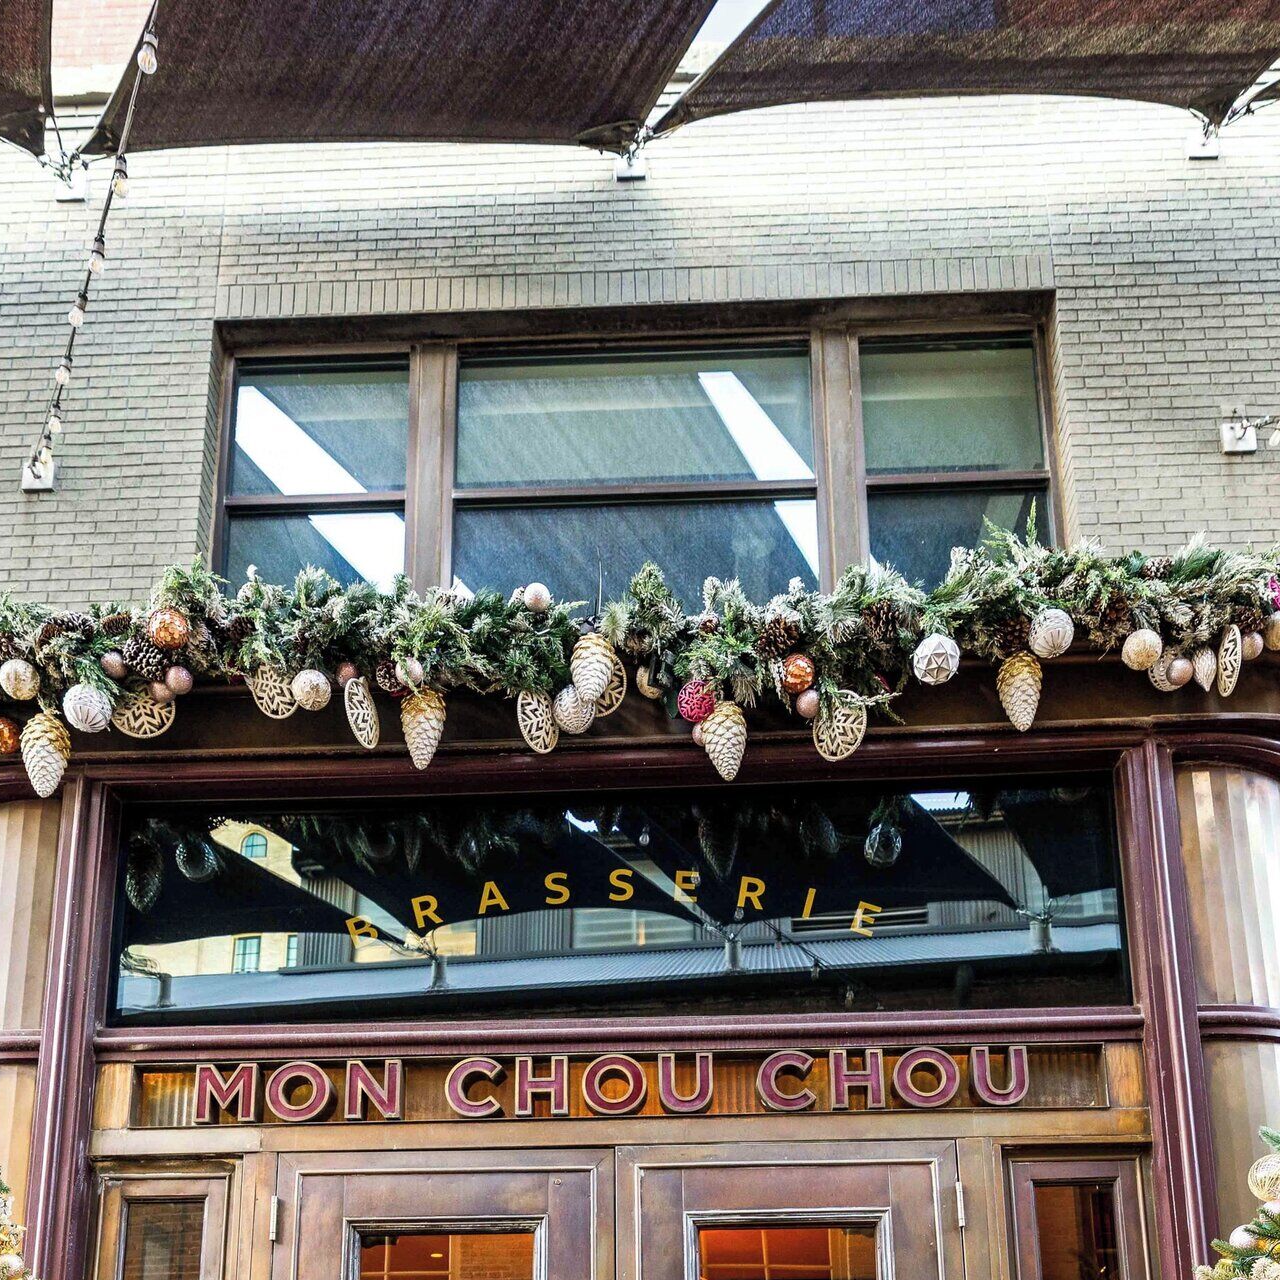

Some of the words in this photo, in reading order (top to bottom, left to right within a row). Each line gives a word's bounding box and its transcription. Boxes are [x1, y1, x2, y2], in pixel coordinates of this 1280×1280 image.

[344, 868, 884, 952] BRASSERIE
[192, 1060, 405, 1126] MON
[444, 1052, 714, 1118] CHOU
[755, 1045, 1031, 1112] CHOU
